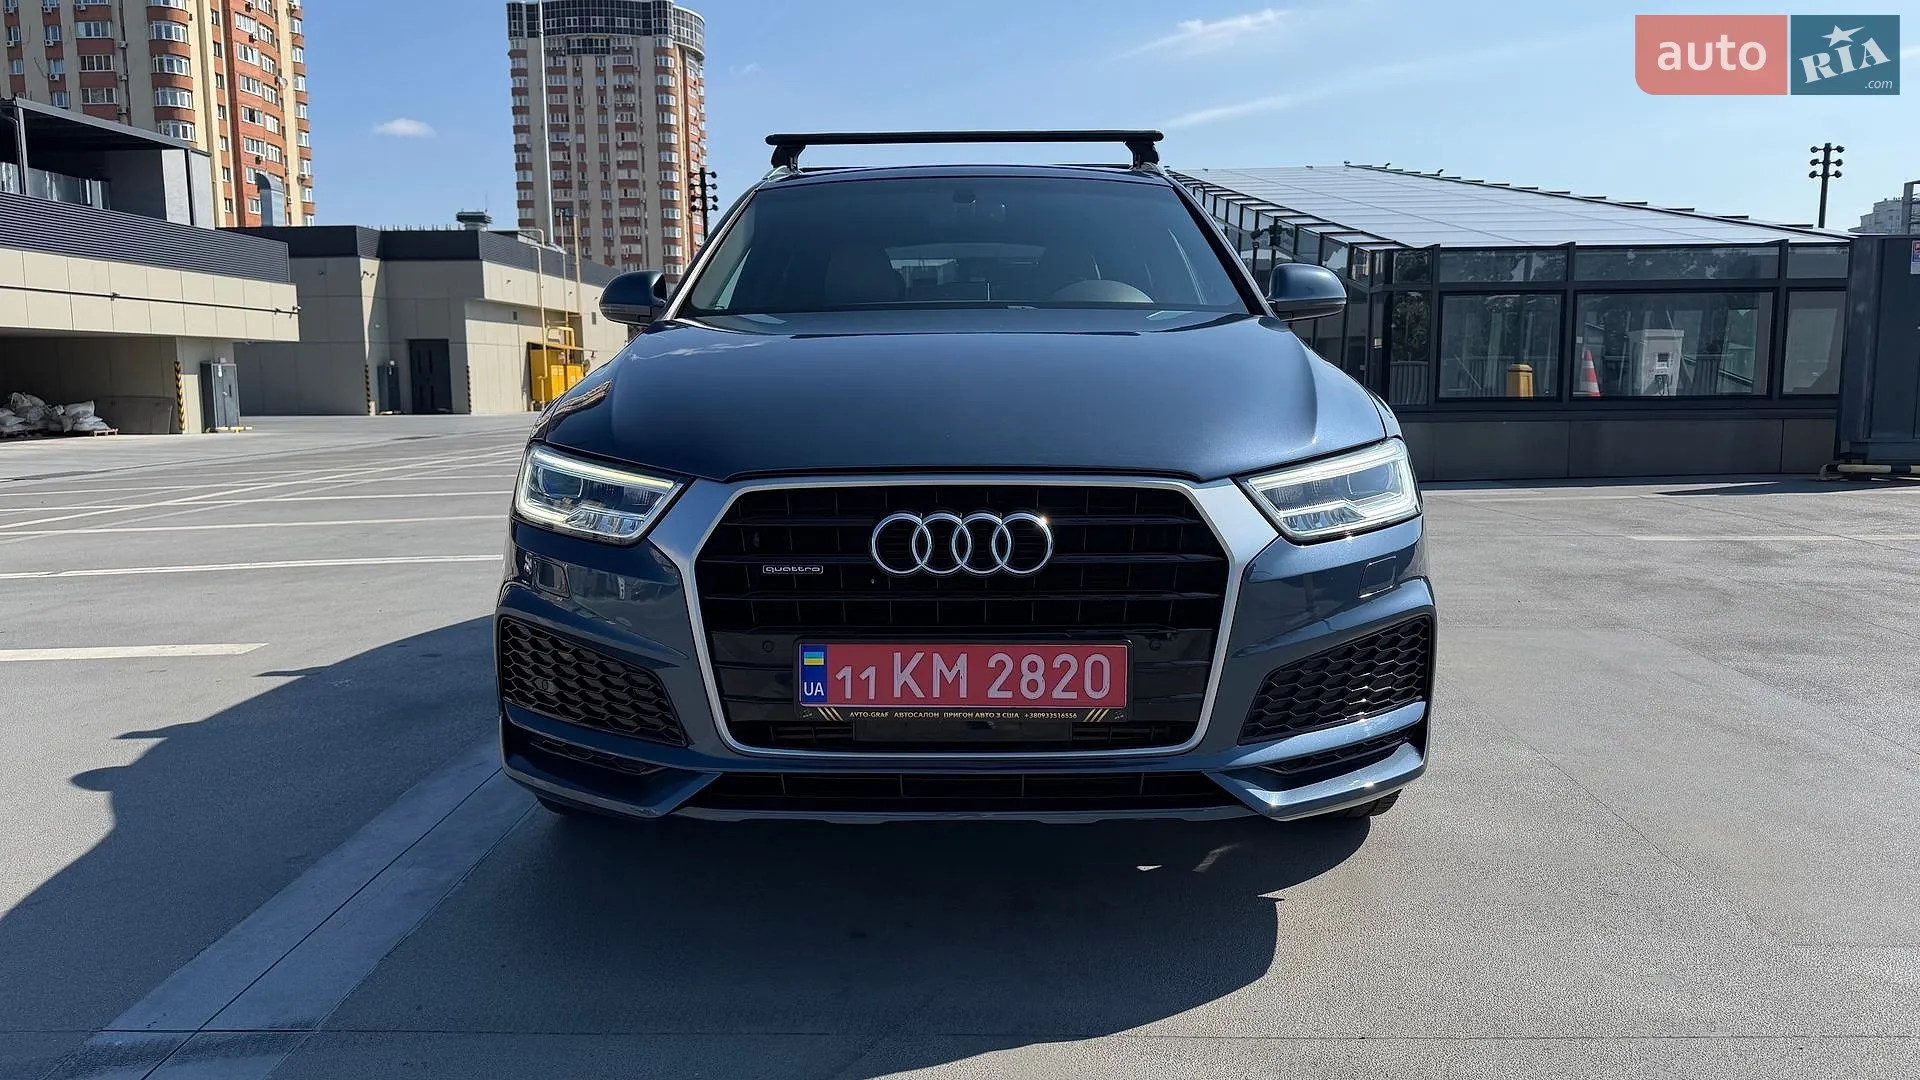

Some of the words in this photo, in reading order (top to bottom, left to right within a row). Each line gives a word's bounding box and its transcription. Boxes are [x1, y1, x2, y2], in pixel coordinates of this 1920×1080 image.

[804, 682, 825, 696] UA
[836, 666, 876, 700] 11
[893, 652, 968, 699] KM
[987, 653, 1111, 700] 2820
